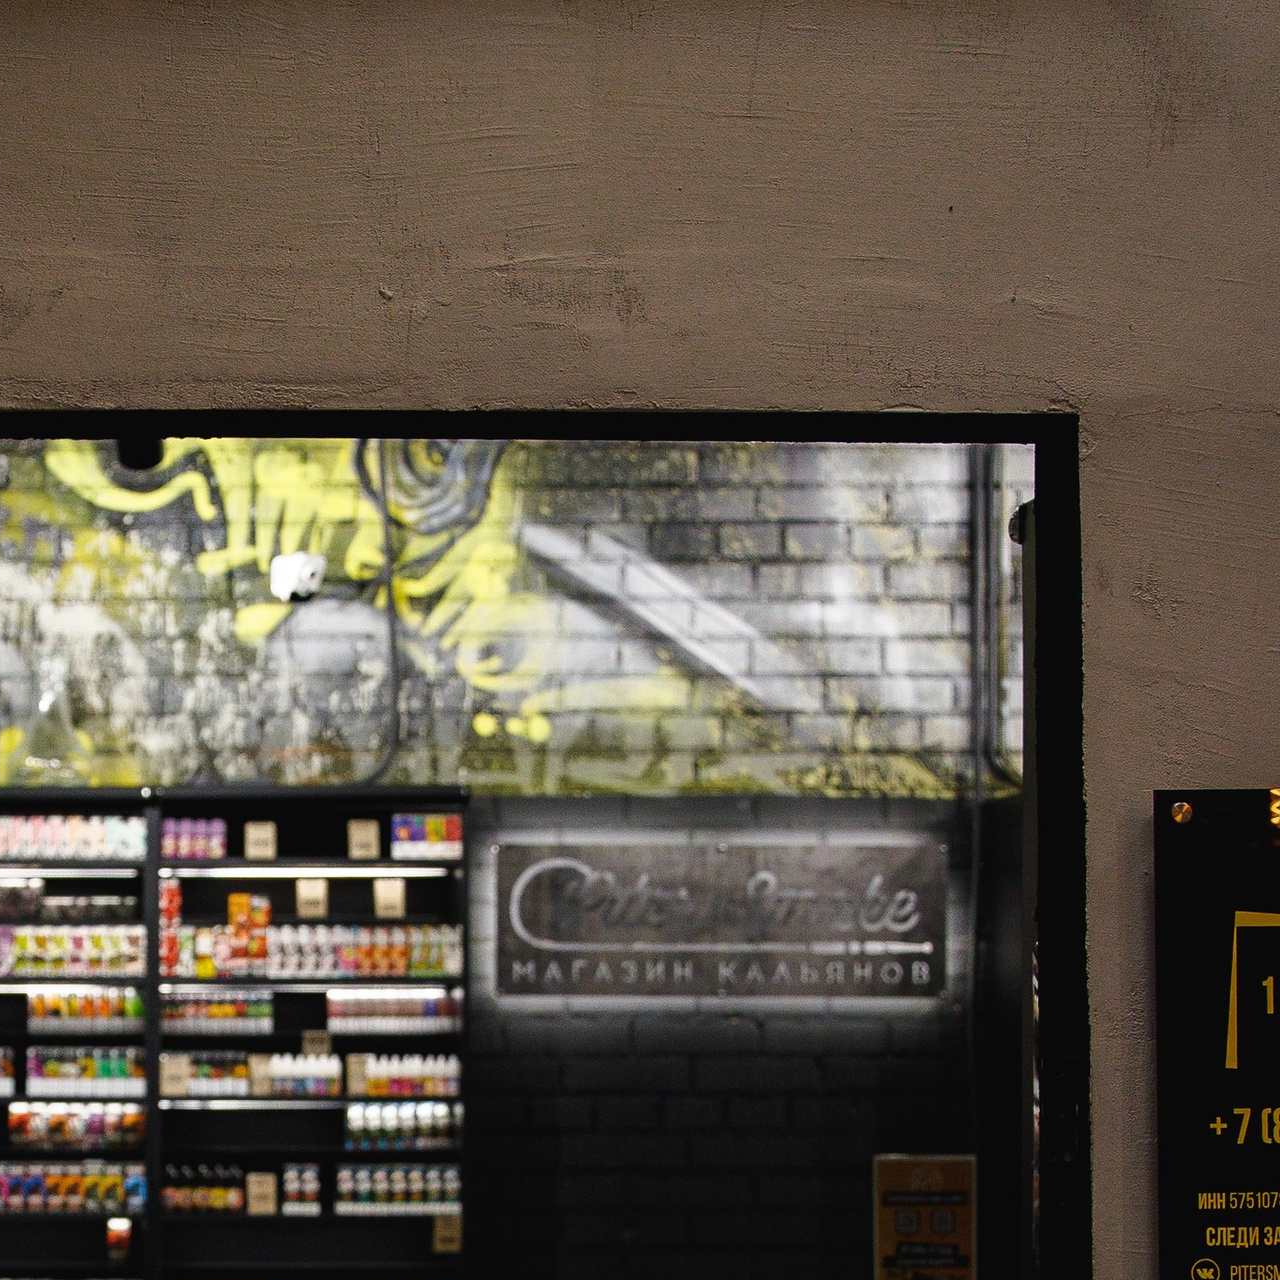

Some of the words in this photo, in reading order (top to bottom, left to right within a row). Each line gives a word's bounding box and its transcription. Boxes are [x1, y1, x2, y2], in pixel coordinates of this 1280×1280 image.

[511, 958, 694, 986] МАГАЗИН
[719, 960, 932, 987] КАЛЬЯНОВ
[1197, 1192, 1226, 1210] ИНН
[1228, 1191, 1280, 1209] 575107
[1206, 1226, 1260, 1249] СЛЕДИ
